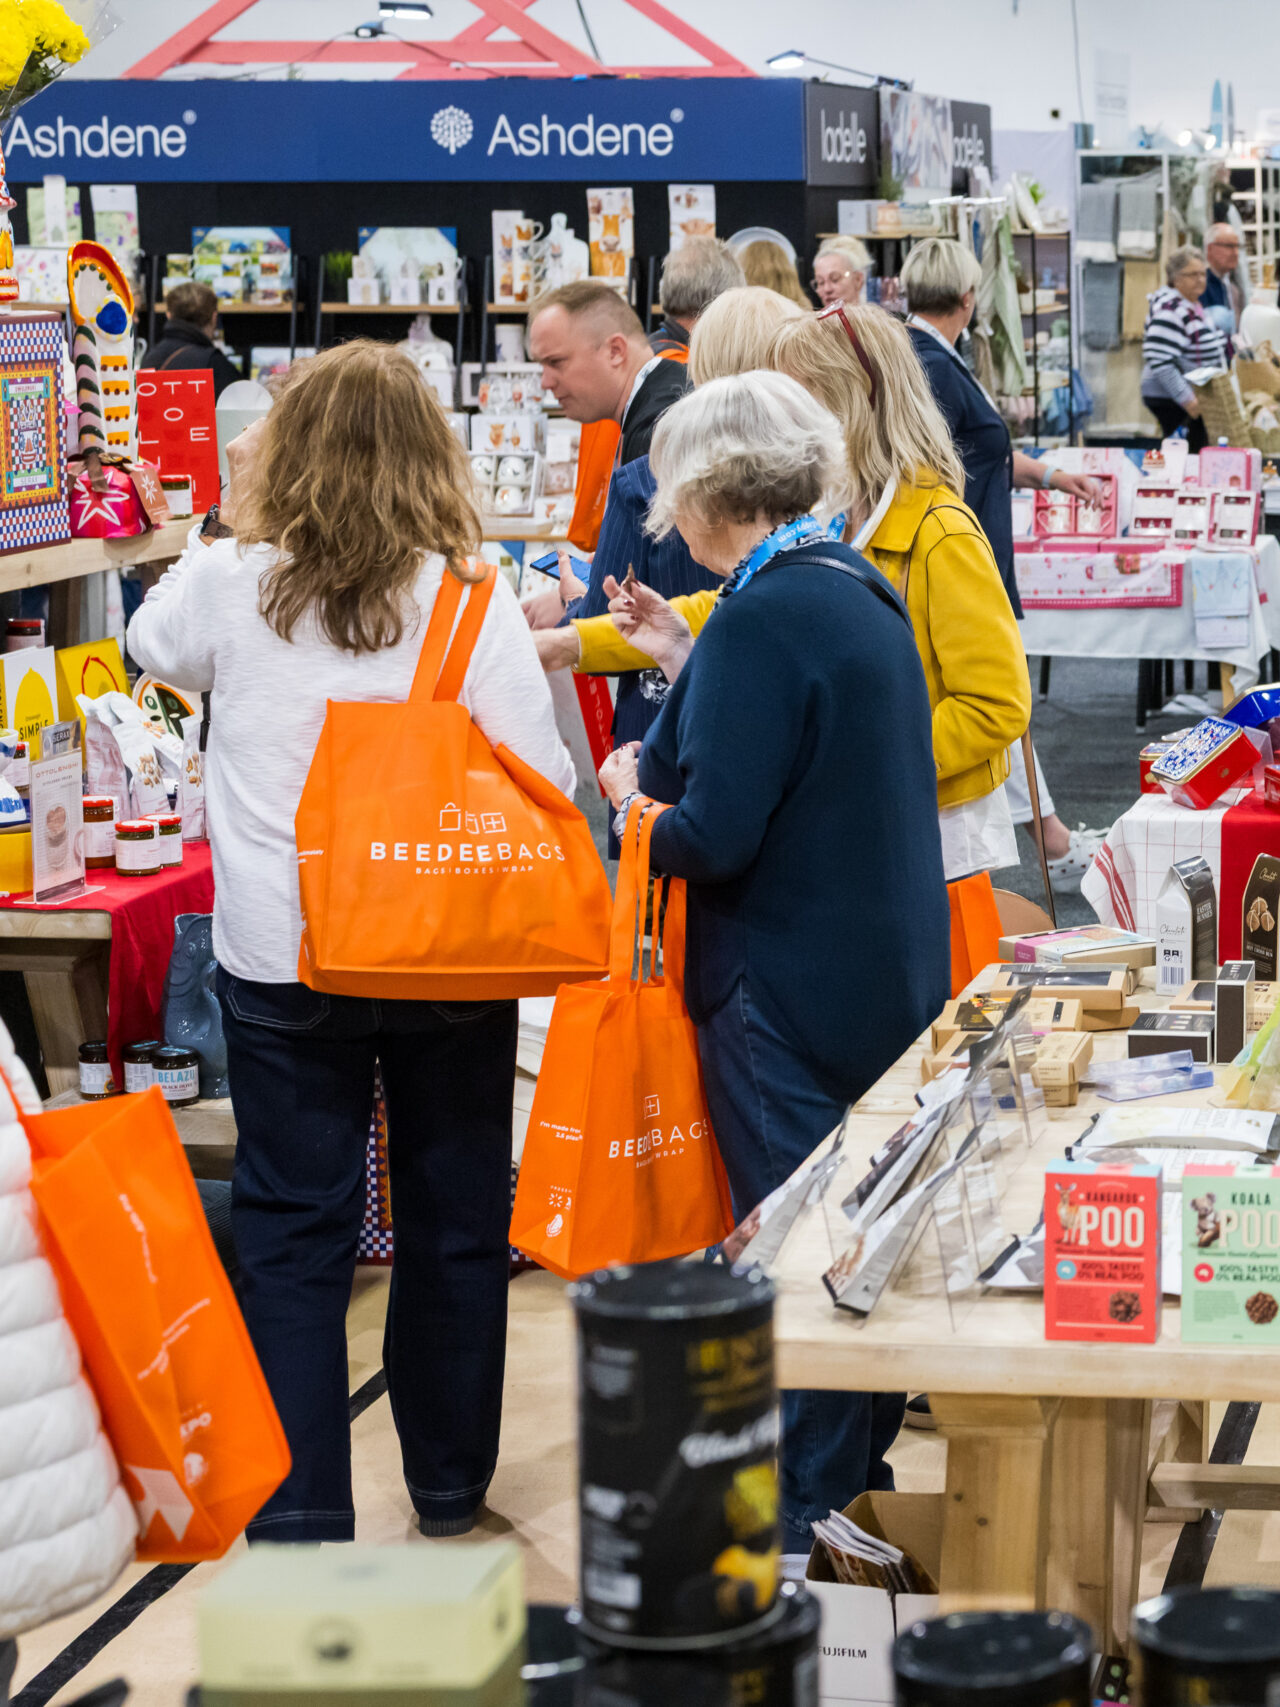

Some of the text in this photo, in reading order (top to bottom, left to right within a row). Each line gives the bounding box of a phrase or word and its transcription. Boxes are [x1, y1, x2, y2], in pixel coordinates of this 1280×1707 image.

[4, 115, 187, 158] Ashdene
[488, 114, 673, 158] Ashdene
[370, 841, 566, 863] BEEDEEBAGS
[416, 865, 534, 875] BAGS BOXES WRAP
[1231, 1192, 1271, 1206] KOALA
[1078, 1205, 1145, 1248] POO
